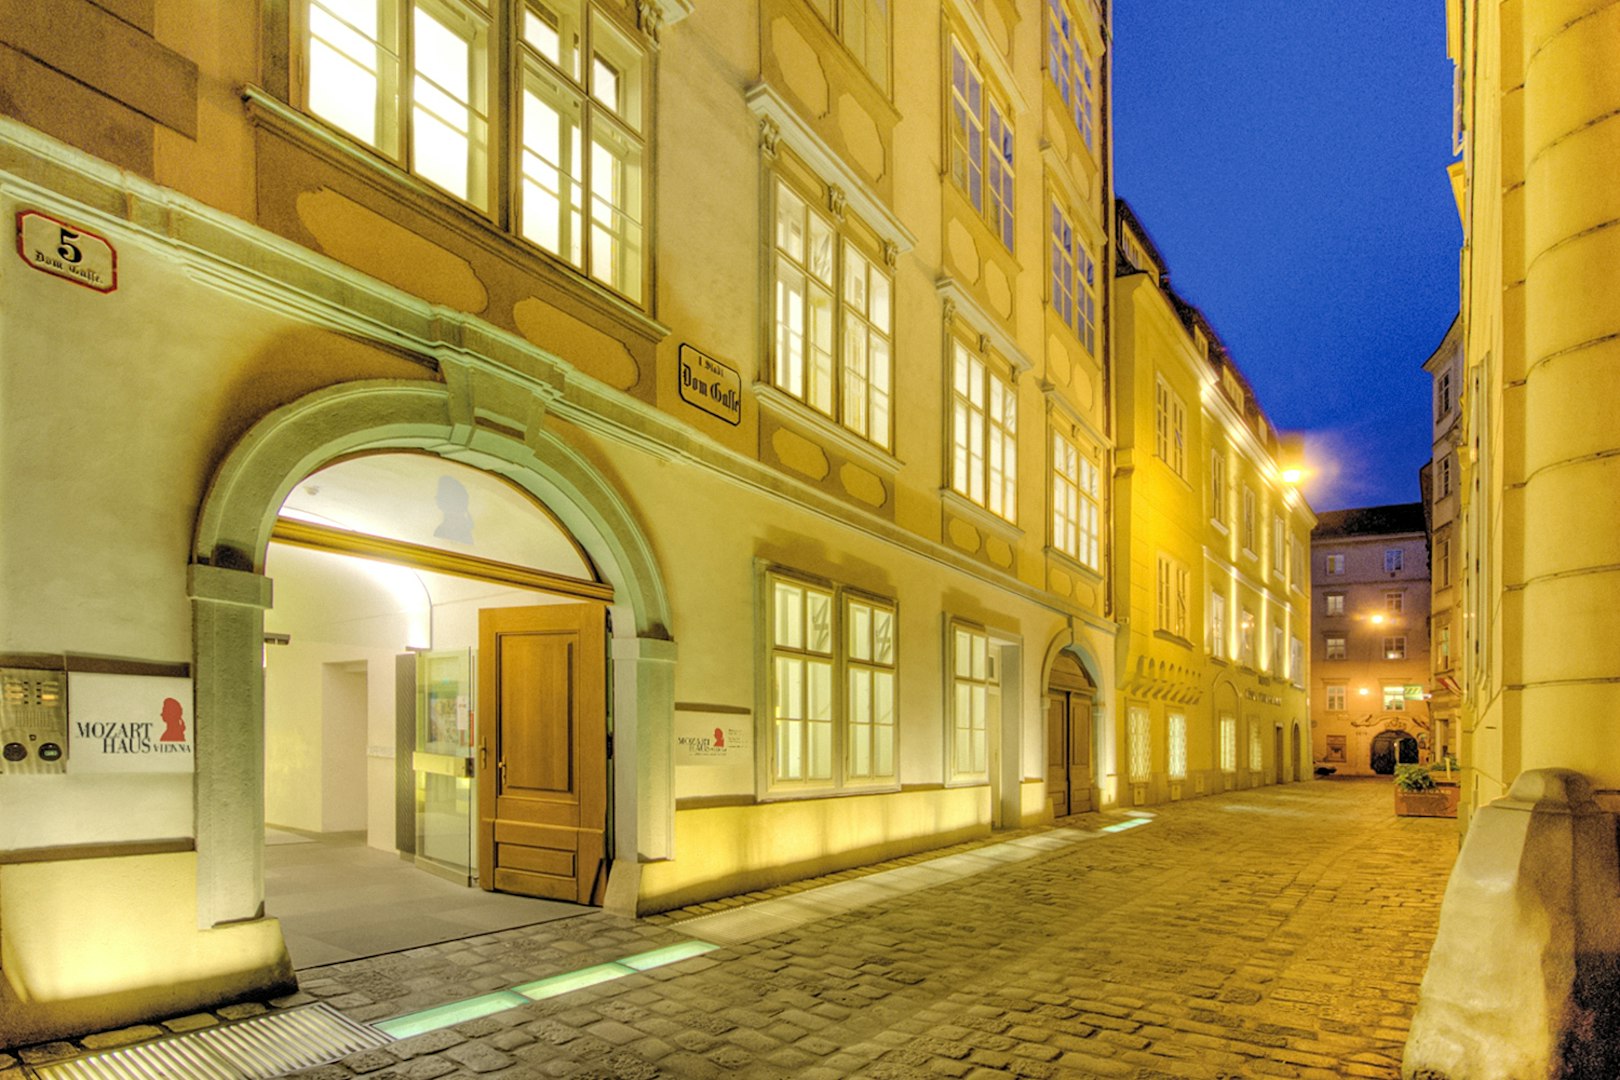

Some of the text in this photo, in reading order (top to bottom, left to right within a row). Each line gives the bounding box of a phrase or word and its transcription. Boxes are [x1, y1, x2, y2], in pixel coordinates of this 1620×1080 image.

[57, 227, 82, 263] 5
[35, 249, 63, 270] Dom
[683, 363, 707, 397] Dom
[76, 721, 153, 739] MOZART
[103, 738, 191, 754] HAUS VIENNA
[678, 737, 710, 745] MOZART
